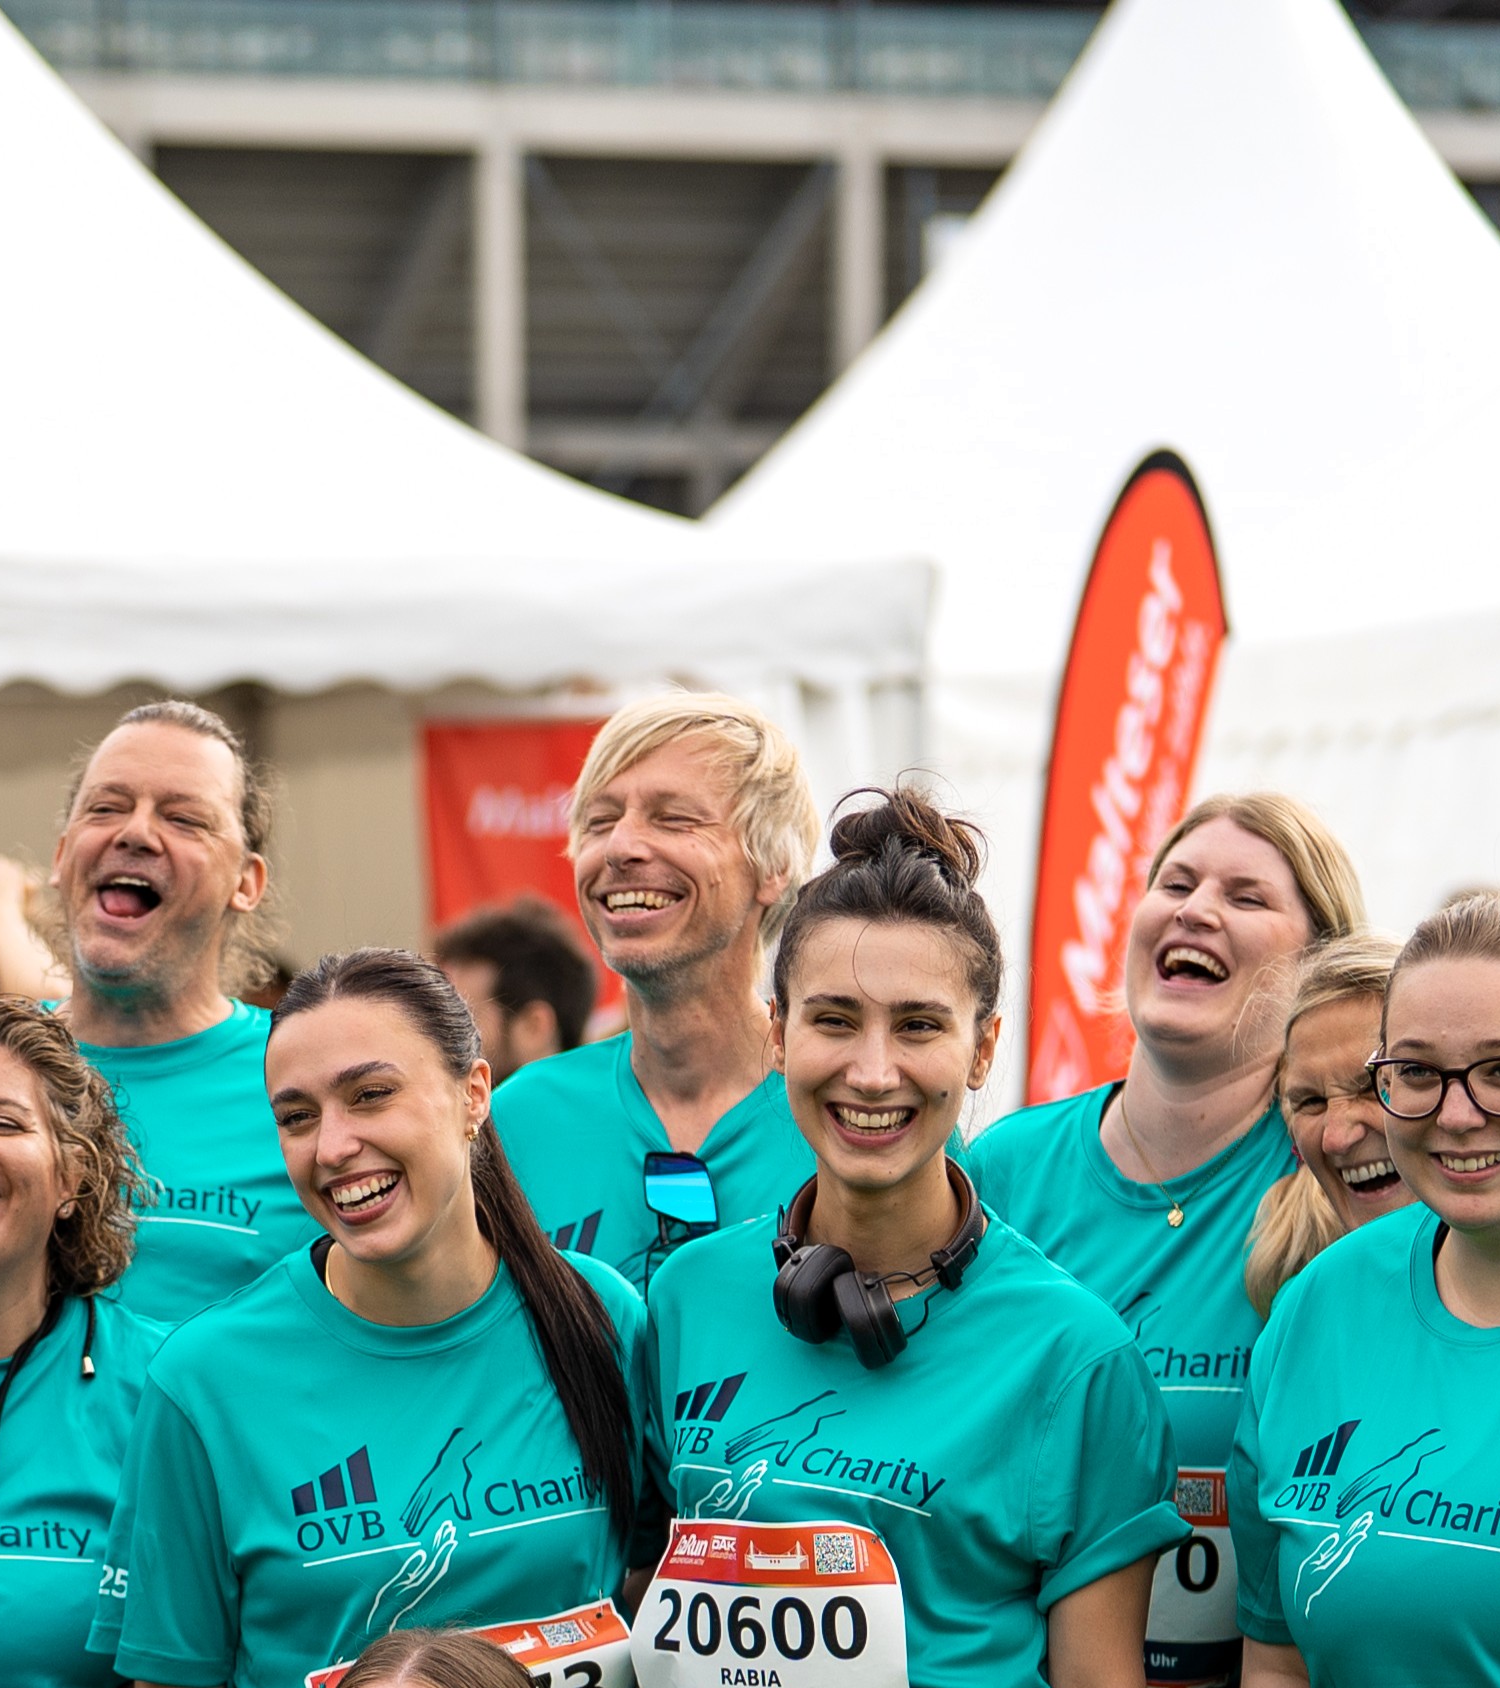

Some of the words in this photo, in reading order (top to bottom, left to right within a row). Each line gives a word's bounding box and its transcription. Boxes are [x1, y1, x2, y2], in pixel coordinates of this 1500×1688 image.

[1062, 537, 1182, 1013] Malteser
[142, 1186, 261, 1226] harity
[803, 1448, 946, 1507] Charity
[1274, 1482, 1330, 1511] OVB
[297, 1510, 385, 1552] OVB
[711, 1535, 736, 1551] DAK
[654, 1588, 868, 1660] 20600
[720, 1668, 782, 1688] RABIA
